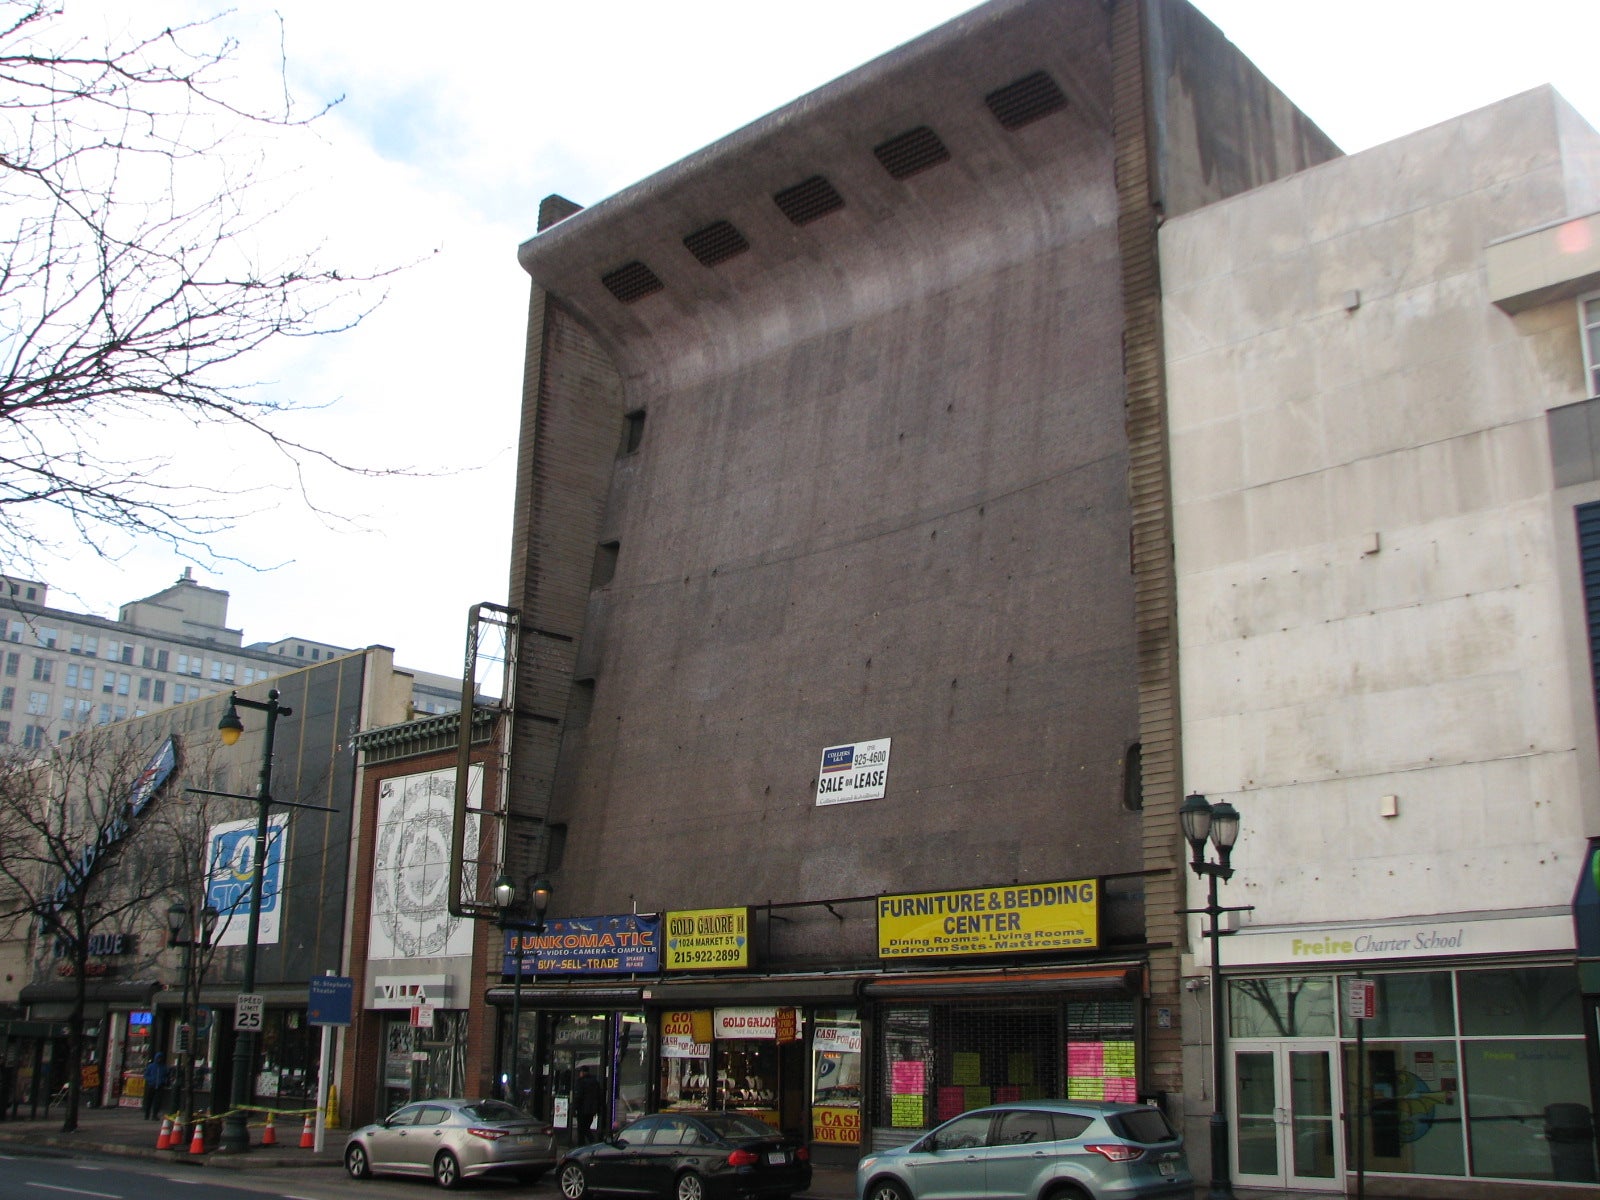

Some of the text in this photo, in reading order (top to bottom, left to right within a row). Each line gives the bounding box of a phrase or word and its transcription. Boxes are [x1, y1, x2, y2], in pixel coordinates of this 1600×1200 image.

[819, 771, 885, 793] SALE OR LEASE
[211, 879, 272, 912] STORS
[880, 884, 1094, 918] FURNITURE & BEDDING
[670, 917, 694, 937] GOLD
[697, 914, 734, 935] GALORE
[943, 912, 1021, 935] CENTER
[510, 931, 653, 950] FUNKOMATIC
[679, 936, 735, 948] 1024 MARKET ST.
[933, 935, 979, 944] Rooms
[989, 932, 1032, 941] Living
[1034, 928, 1084, 937] Rooms
[1291, 929, 1463, 956] Freire Charter School
[881, 944, 949, 955] Bedroom
[994, 937, 1093, 949] Mattresses
[239, 996, 262, 1004] SPEED
[382, 985, 426, 1000] VILLA
[238, 1013, 260, 1027] 25
[723, 1016, 777, 1028] GOLD GALOR
[661, 1036, 678, 1046] CASH
[815, 1028, 837, 1039] CASH
[815, 1128, 836, 1140] FOR
